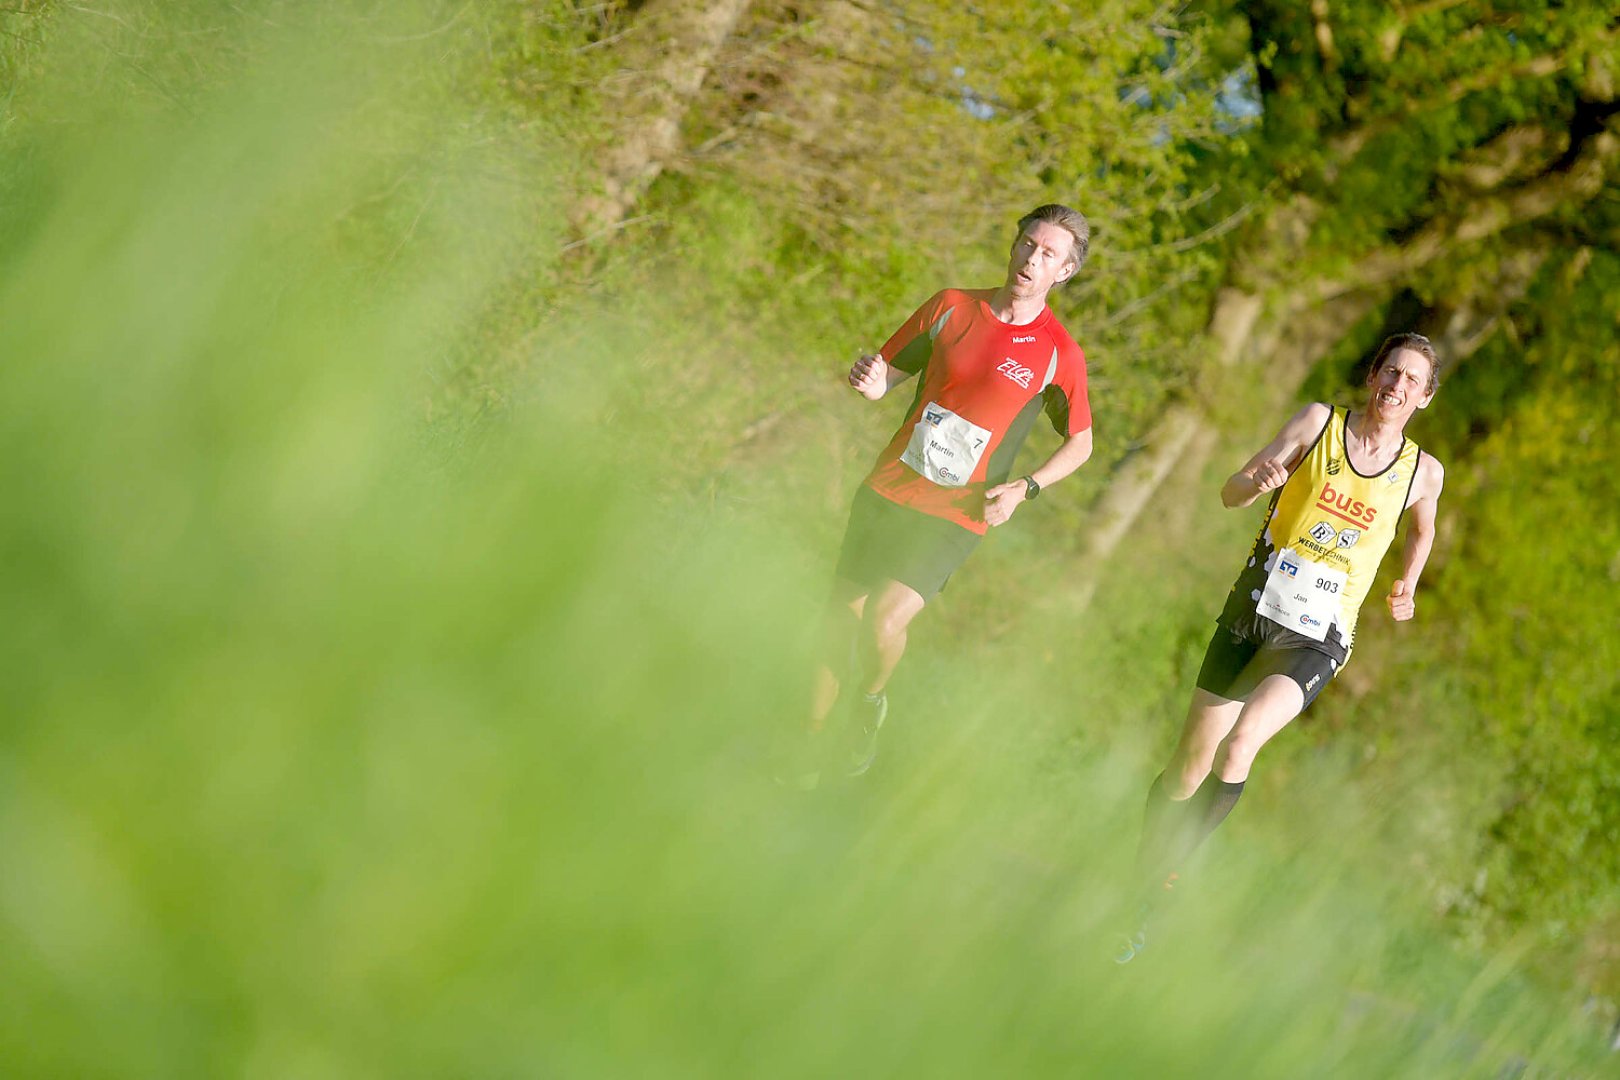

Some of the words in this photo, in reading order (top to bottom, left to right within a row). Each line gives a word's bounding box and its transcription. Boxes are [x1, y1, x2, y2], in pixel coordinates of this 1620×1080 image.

[1012, 335, 1036, 344] Martin
[929, 440, 955, 458] Martin
[973, 437, 984, 449] 7
[1319, 482, 1378, 524] buss
[1312, 526, 1326, 540] B
[1339, 535, 1350, 548] S
[1315, 578, 1339, 594] 903
[1293, 593, 1308, 604] Jan
